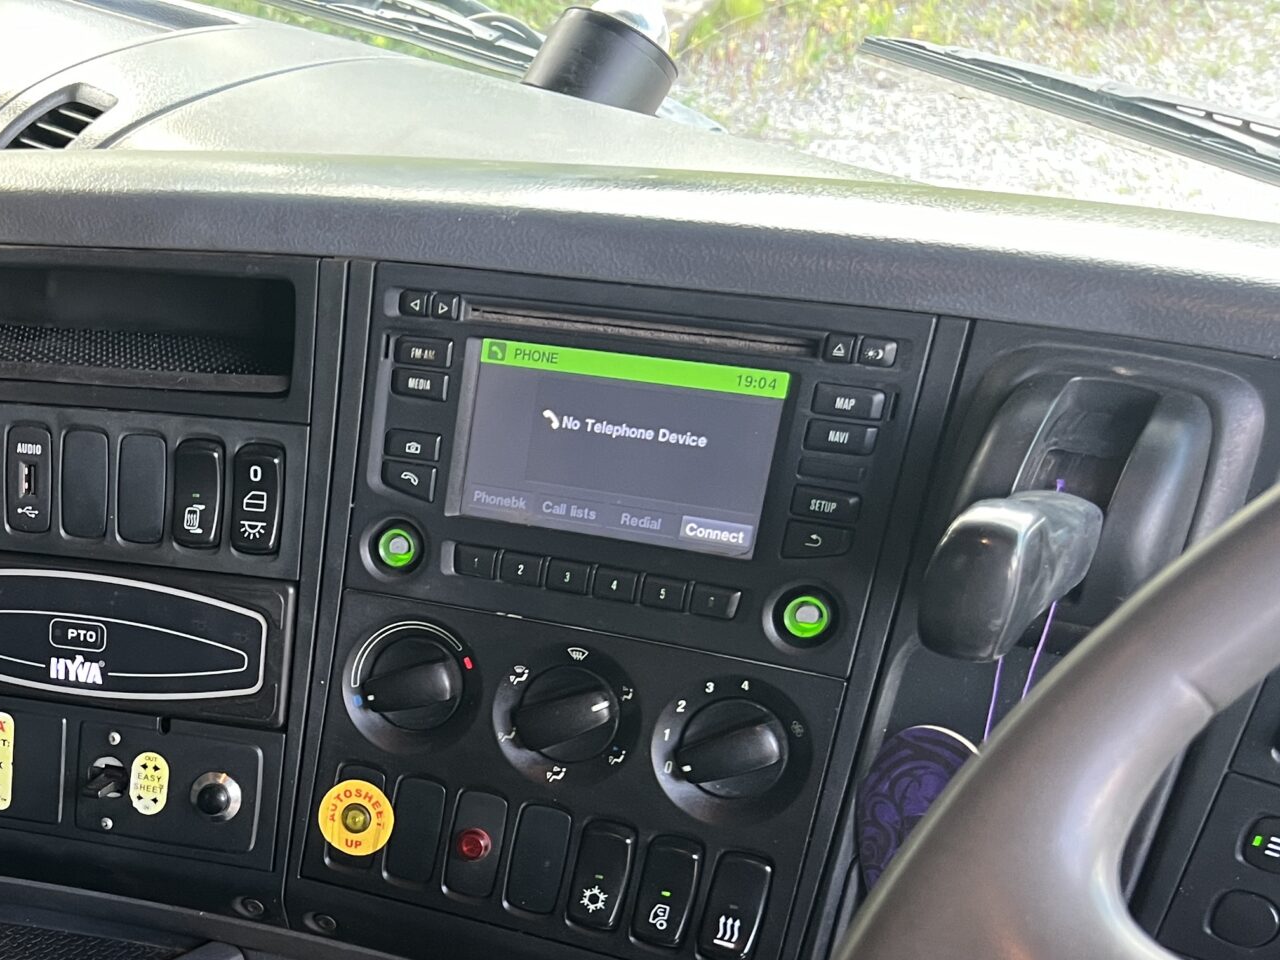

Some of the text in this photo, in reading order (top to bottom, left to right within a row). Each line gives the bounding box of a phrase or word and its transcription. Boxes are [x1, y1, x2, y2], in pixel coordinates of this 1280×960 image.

[513, 348, 559, 365] PHONE
[408, 377, 431, 391] MEDIA
[735, 374, 778, 391] 19:04
[835, 397, 856, 411] MAP
[561, 415, 708, 448] No Telephone Device
[828, 430, 849, 444] NAVI
[17, 443, 42, 455] AUDIO
[473, 490, 527, 510] Phonebk
[810, 499, 837, 513] SETUP
[542, 501, 597, 520] Call lists
[620, 513, 662, 530] Redial
[685, 523, 745, 544] Connect
[518, 564, 524, 575] 2
[564, 572, 571, 583] 3
[611, 580, 618, 591] 4
[660, 589, 666, 600] 5
[68, 629, 97, 643] PTO
[705, 682, 715, 693] 3
[741, 680, 750, 691] 4
[676, 700, 687, 713] 2
[664, 729, 671, 741] 1
[664, 761, 673, 774] 0
[138, 773, 162, 783] EASY
[345, 839, 362, 849] UP
